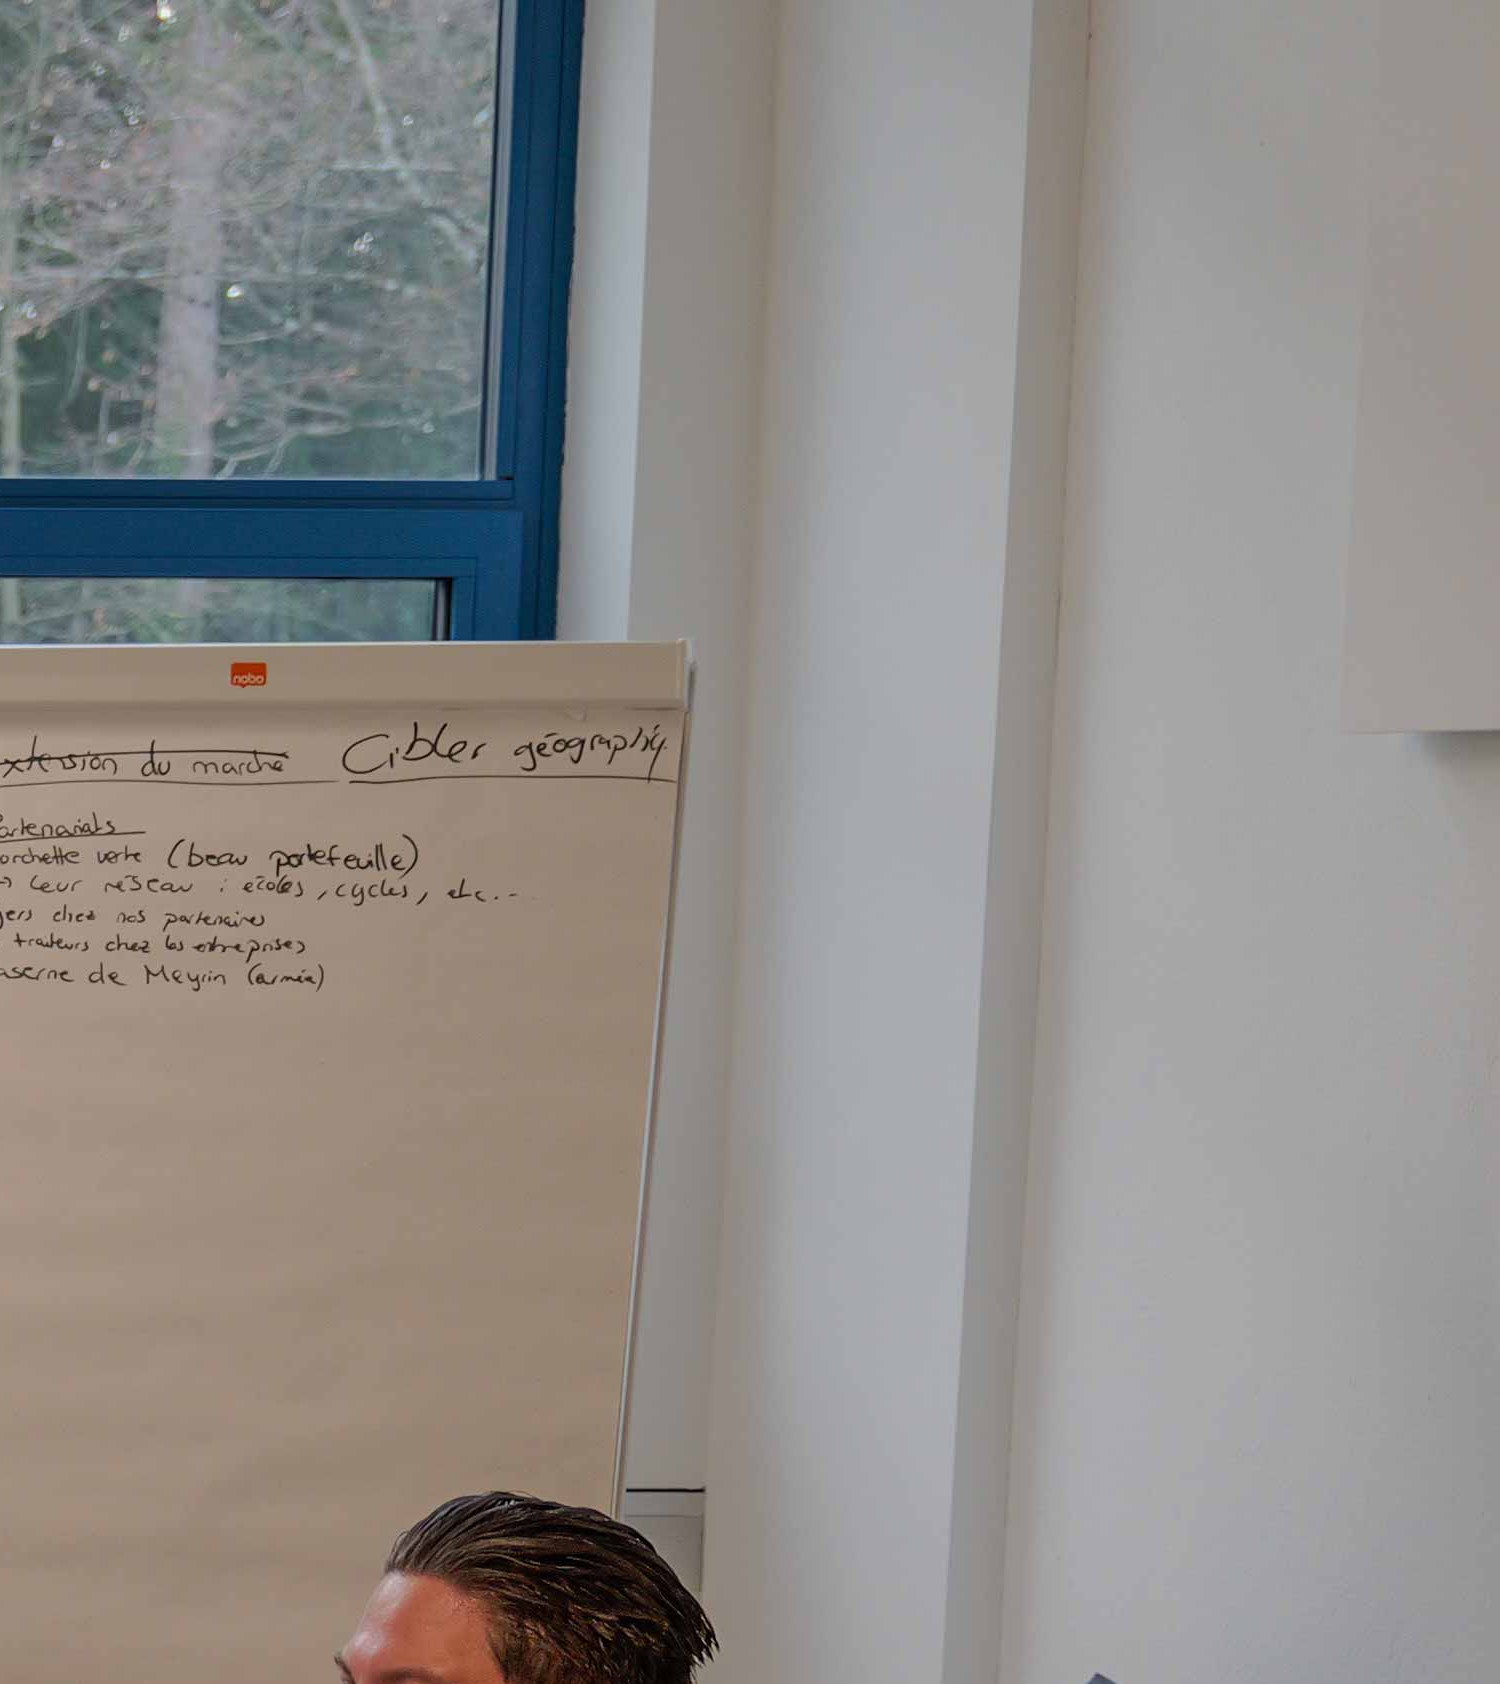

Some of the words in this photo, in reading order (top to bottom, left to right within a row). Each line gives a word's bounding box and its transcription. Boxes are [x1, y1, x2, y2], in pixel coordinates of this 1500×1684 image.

[232, 672, 265, 685] nobo
[141, 739, 173, 778] du
[52, 903, 97, 923] chez
[115, 907, 147, 925] nos
[162, 910, 267, 932] partenaires
[13, 933, 90, 952] traiteurs
[104, 932, 152, 953] chez
[88, 961, 128, 985] de
[144, 964, 227, 991] Meyrin
